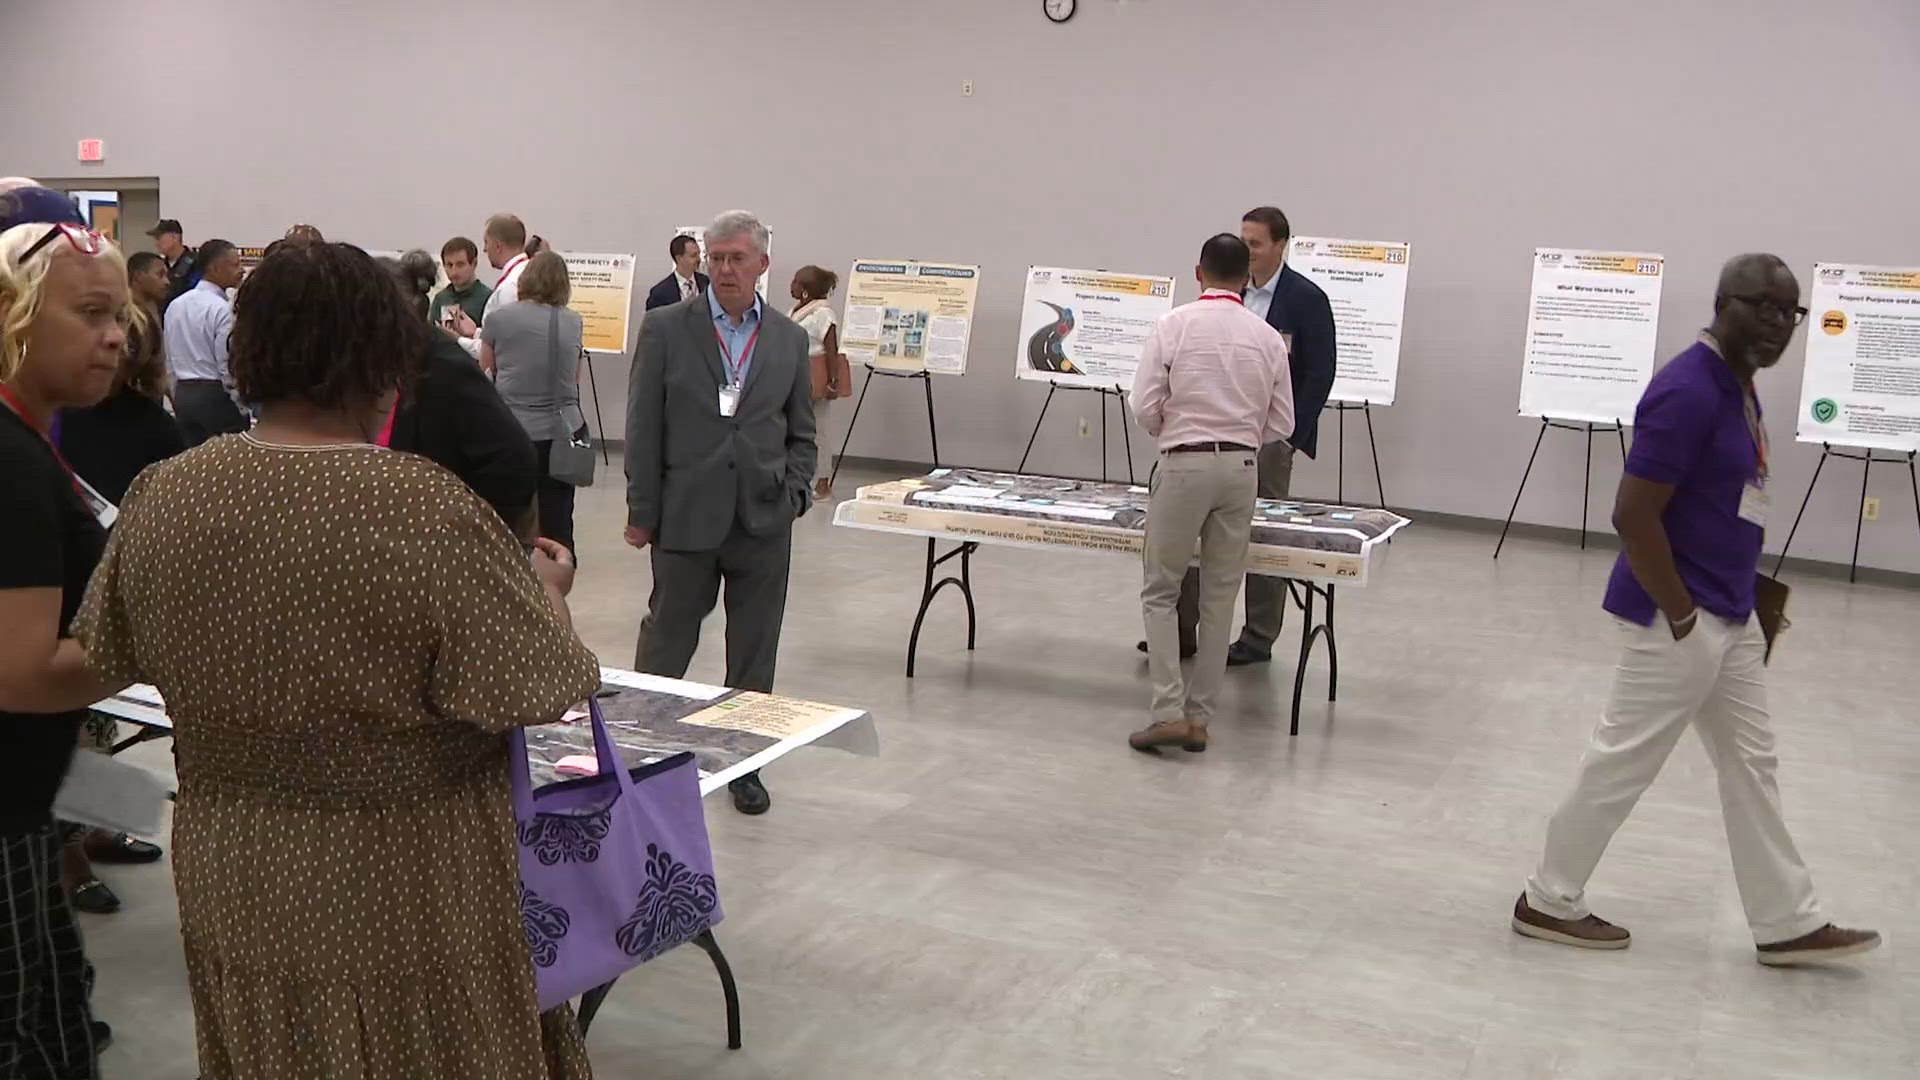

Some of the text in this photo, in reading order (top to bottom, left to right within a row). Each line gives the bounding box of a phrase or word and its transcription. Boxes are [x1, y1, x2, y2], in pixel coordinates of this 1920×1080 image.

[1386, 252, 1403, 261] 210
[1638, 264, 1655, 273] 210
[1151, 286, 1167, 295] 210
[1075, 293, 1095, 301] Project
[1839, 294, 1864, 302] Project
[1866, 296, 1894, 304] Purpose
[1043, 530, 1089, 540] CONSTRUCTION
